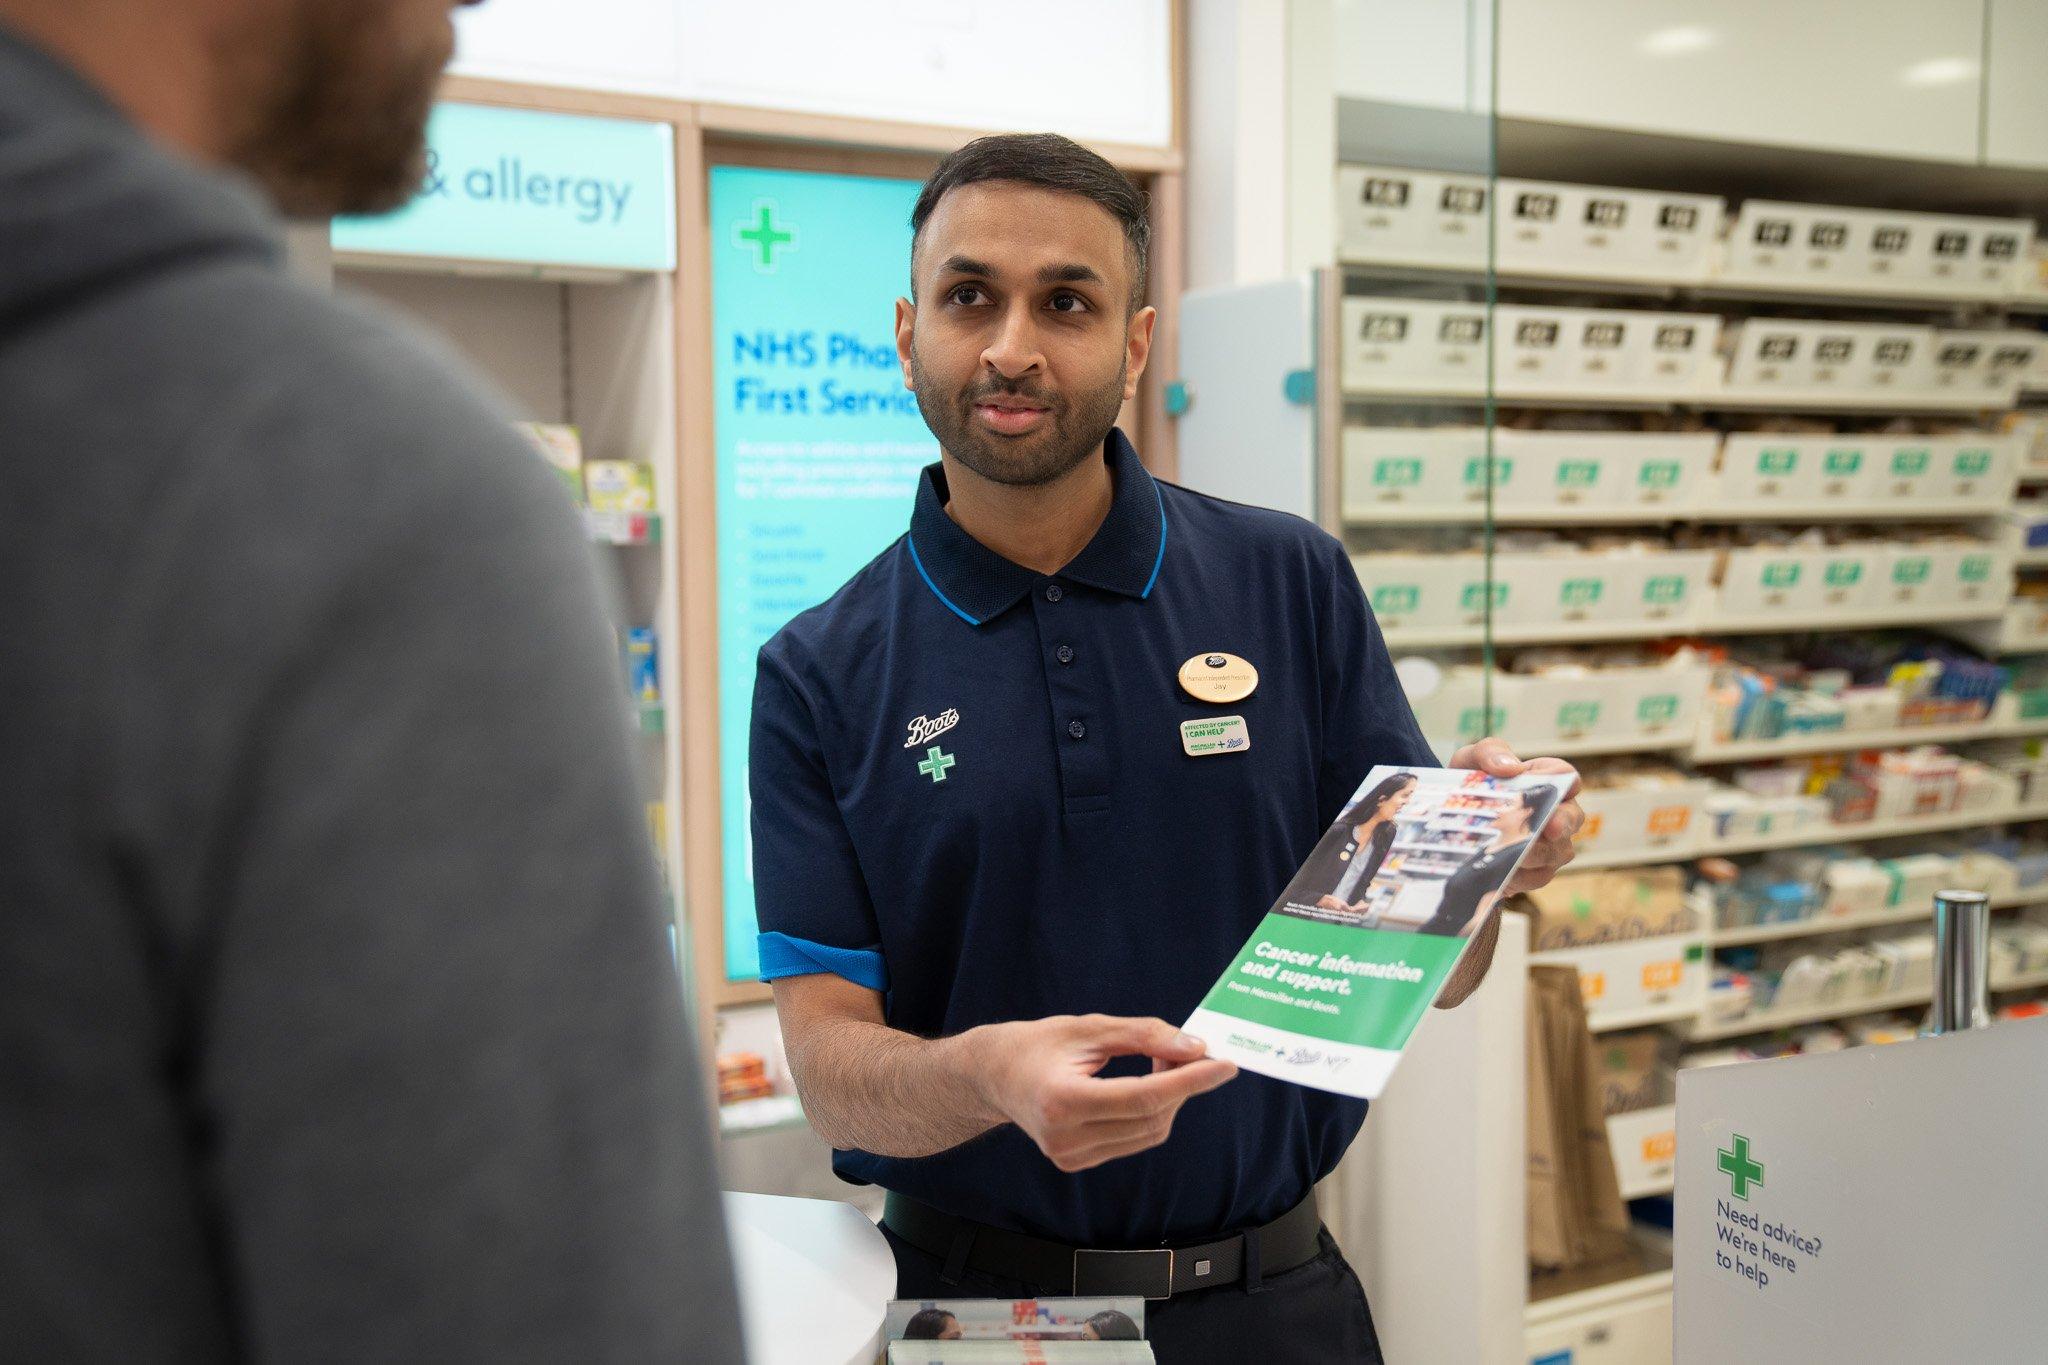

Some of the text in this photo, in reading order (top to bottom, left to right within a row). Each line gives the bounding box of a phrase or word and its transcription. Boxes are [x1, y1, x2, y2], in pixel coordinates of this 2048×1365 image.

[421, 148, 633, 224] & allergy
[733, 331, 898, 369] NHS Pha
[734, 377, 919, 416] First Servic
[1213, 683, 1227, 691] Jay
[904, 708, 960, 748] Boots
[1189, 730, 1206, 738] CAN
[1206, 728, 1225, 736] HELP
[1240, 960, 1353, 996] and support.
[1254, 940, 1425, 984] Cancer information
[1227, 980, 1251, 994] From
[1250, 986, 1294, 1004] Macmillan
[1293, 996, 1313, 1009] and
[1716, 1198, 1823, 1258] Need advice?
[1716, 1222, 1797, 1274] We're here
[1716, 1249, 1770, 1290] to help
